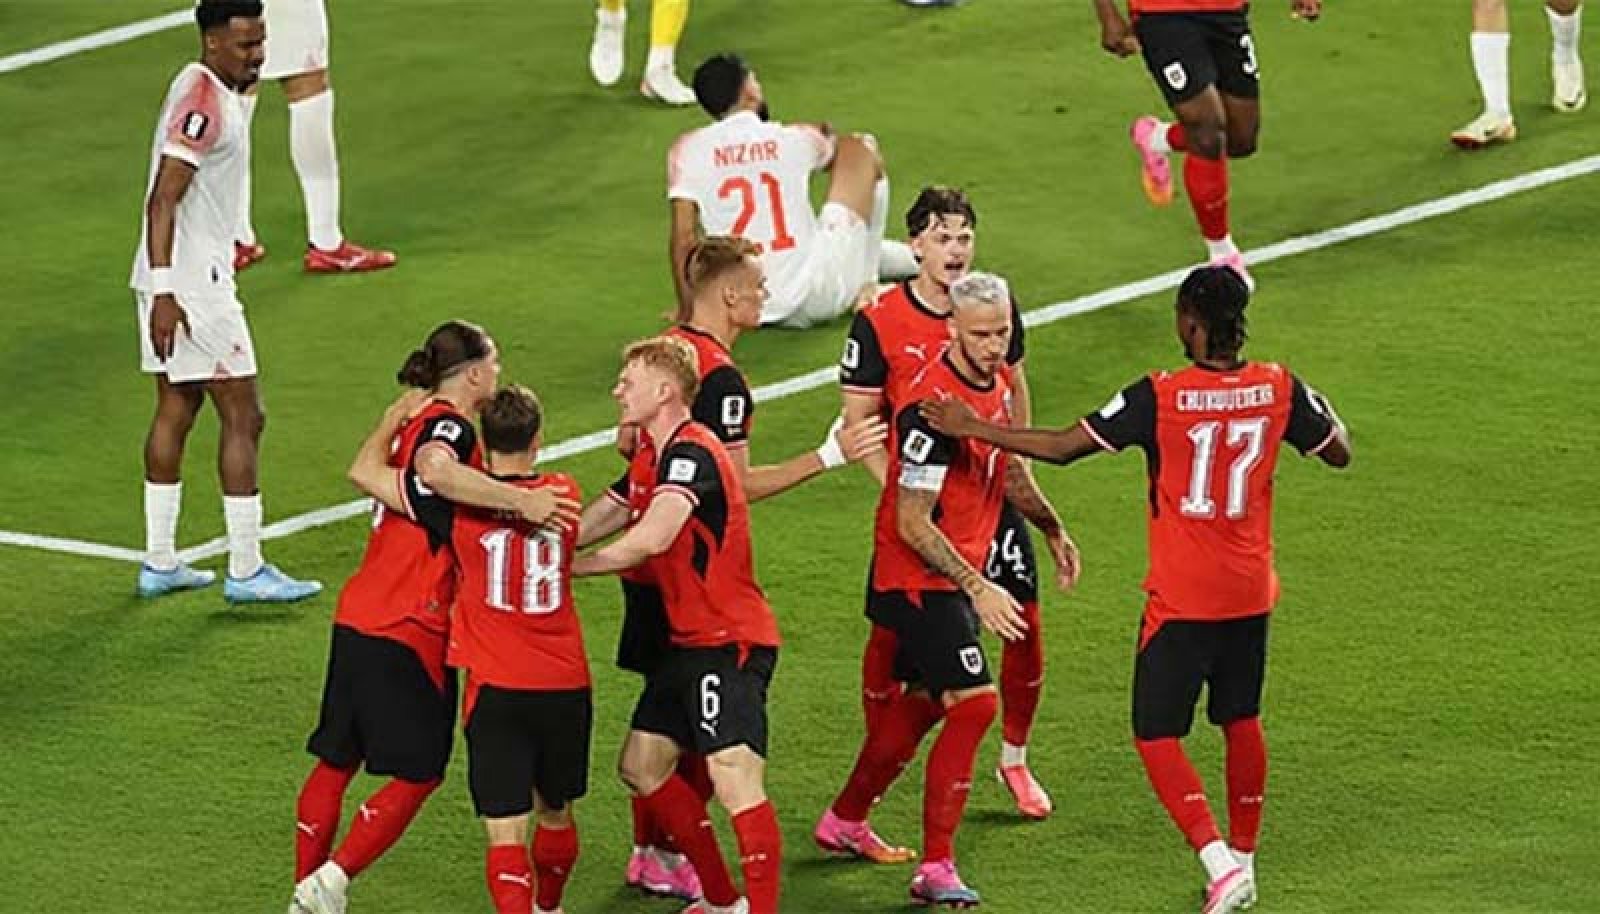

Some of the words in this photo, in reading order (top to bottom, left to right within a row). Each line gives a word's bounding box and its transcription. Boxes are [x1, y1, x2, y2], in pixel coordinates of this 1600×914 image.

[1240, 34, 1257, 74] 3
[713, 141, 779, 167] NIZAR
[718, 172, 796, 253] 21
[1180, 417, 1271, 519] 17
[480, 529, 562, 614] 18
[701, 673, 720, 720] 6
